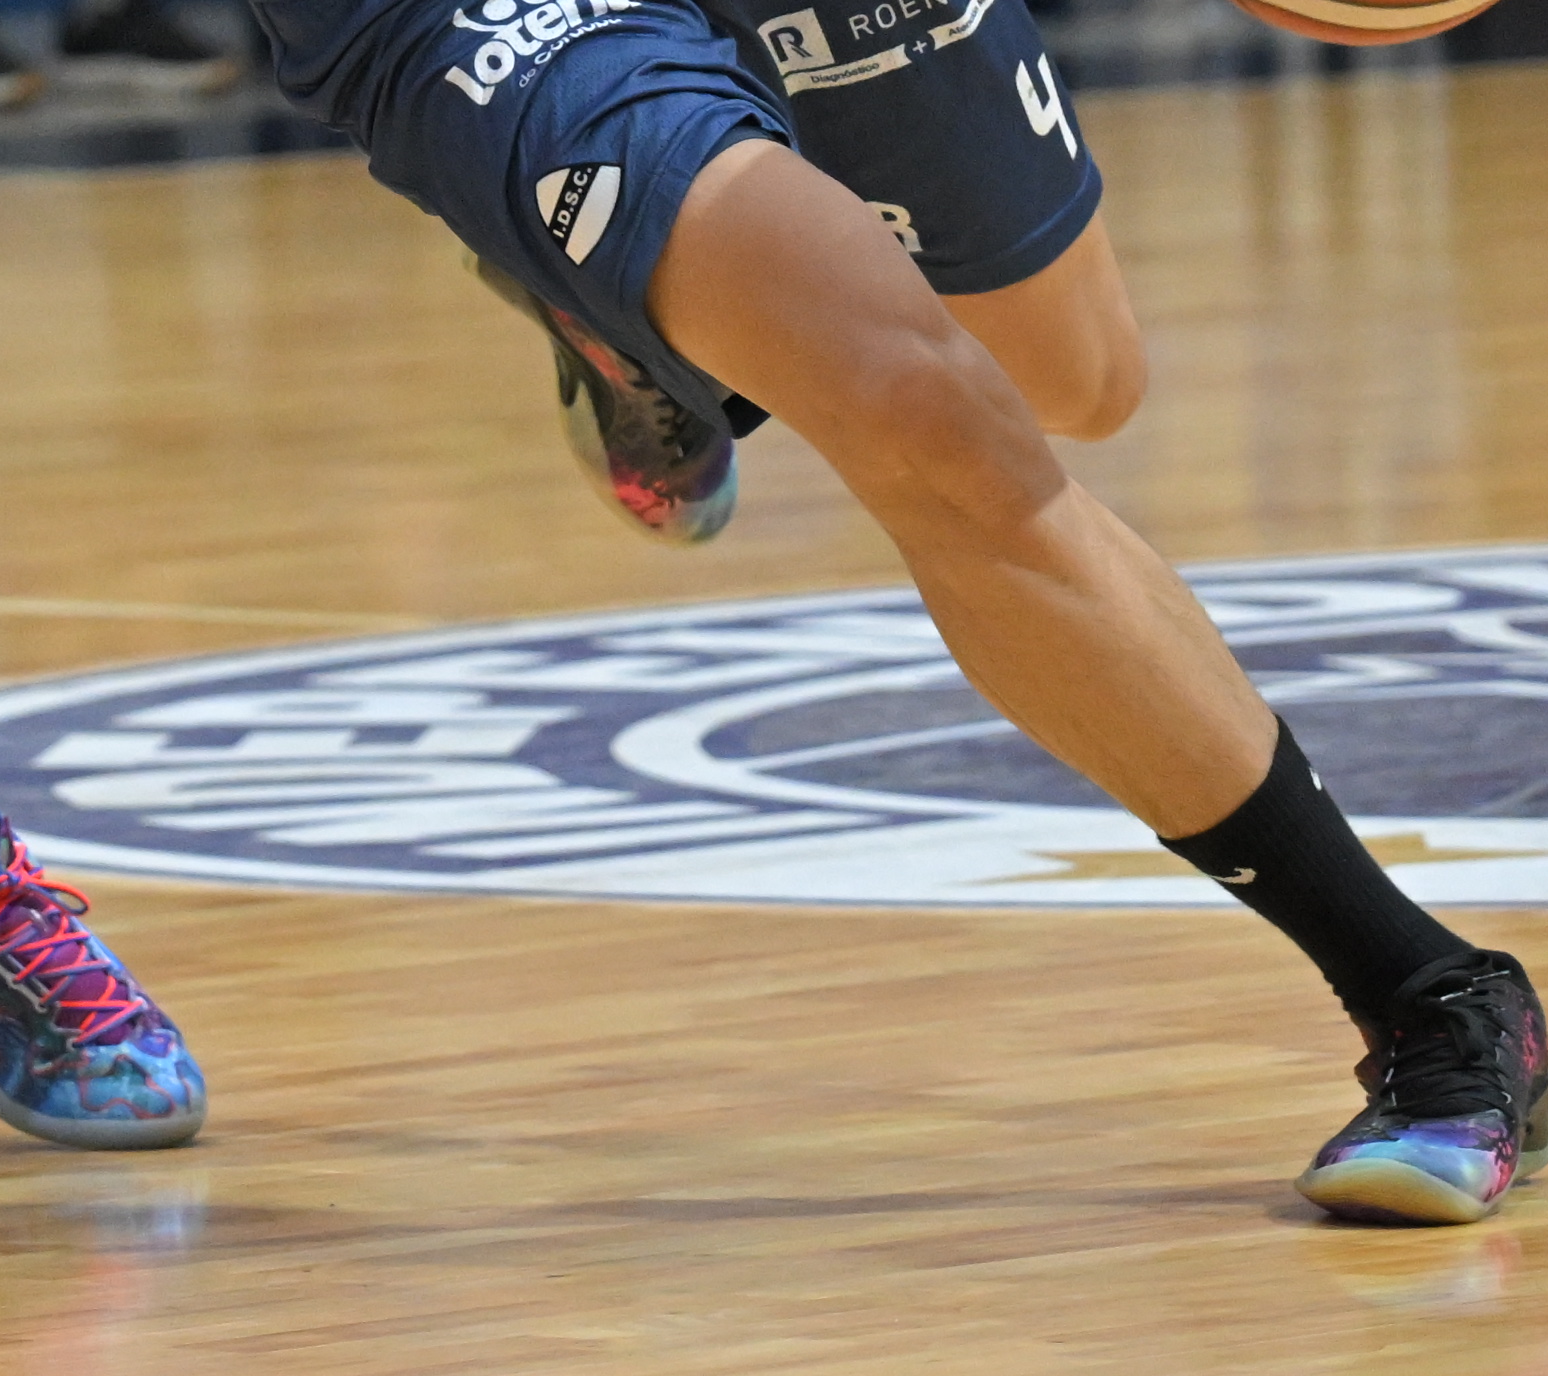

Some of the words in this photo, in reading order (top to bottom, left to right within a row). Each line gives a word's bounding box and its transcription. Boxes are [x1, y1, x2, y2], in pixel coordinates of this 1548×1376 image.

[810, 61, 881, 84] Diagnóstico
[1015, 52, 1079, 161] 4
[552, 166, 594, 239] I.D.S.C.
